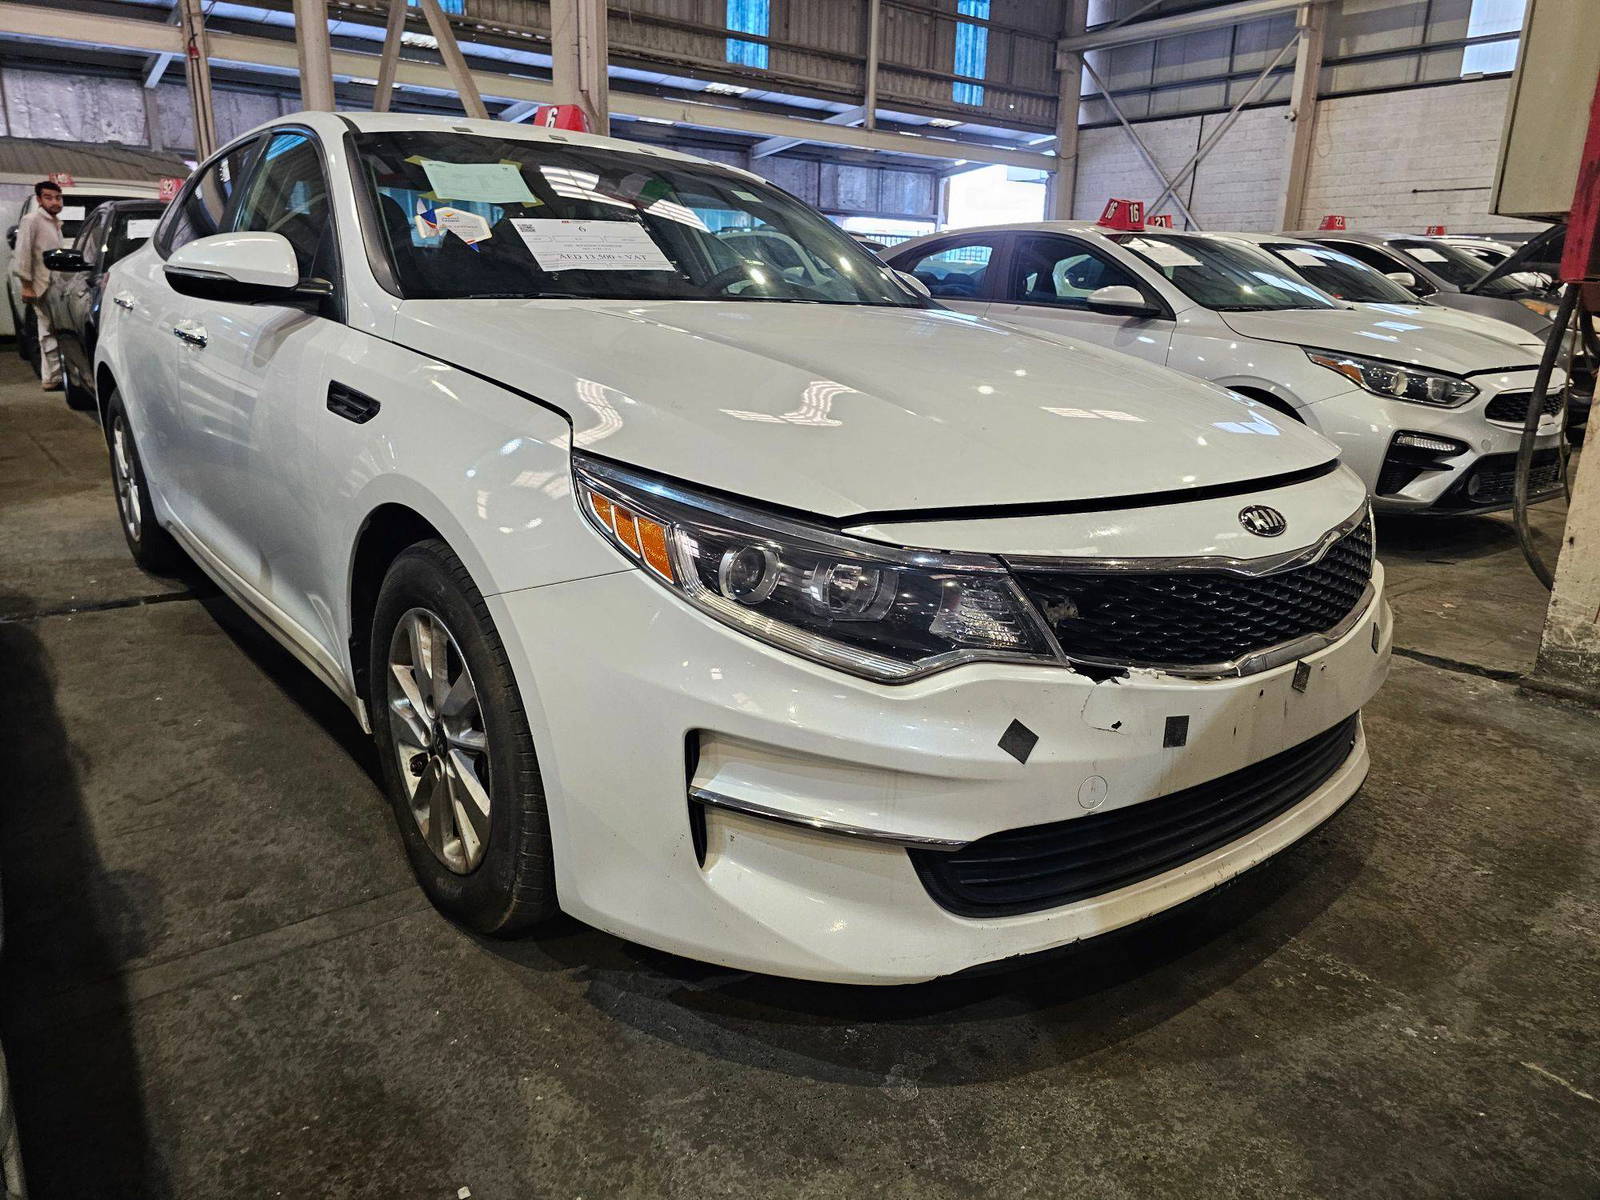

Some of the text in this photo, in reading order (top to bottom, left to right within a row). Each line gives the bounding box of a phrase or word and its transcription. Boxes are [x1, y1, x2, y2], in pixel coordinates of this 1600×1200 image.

[546, 107, 558, 128] 6
[1105, 201, 1118, 219] 16
[1130, 204, 1139, 223] 16
[1155, 216, 1166, 228] 21
[624, 253, 647, 261] VAT
[1245, 508, 1285, 530] KIA
